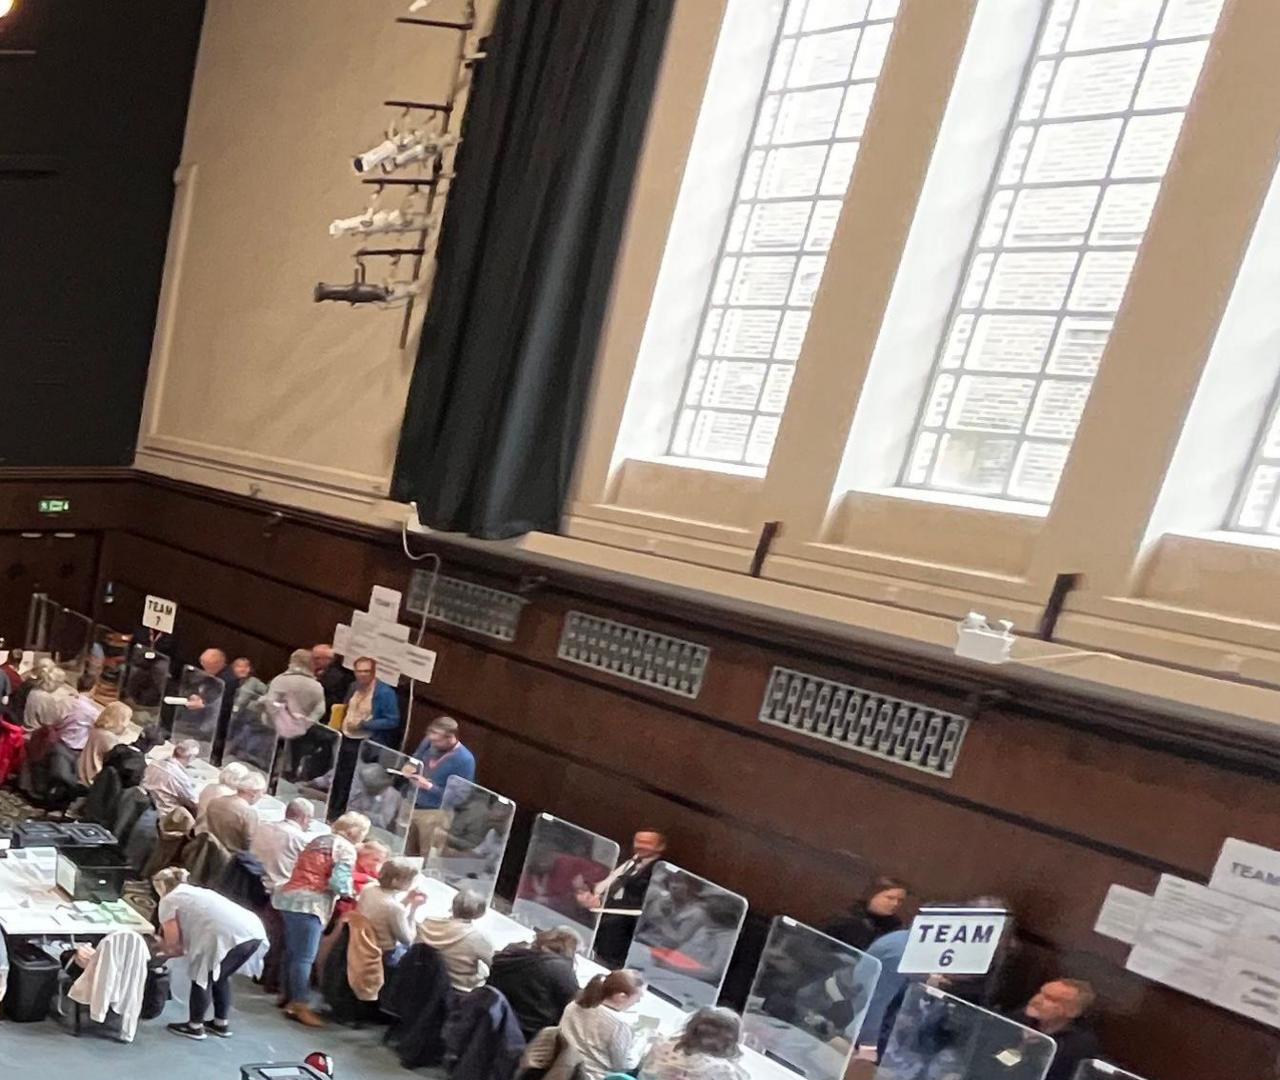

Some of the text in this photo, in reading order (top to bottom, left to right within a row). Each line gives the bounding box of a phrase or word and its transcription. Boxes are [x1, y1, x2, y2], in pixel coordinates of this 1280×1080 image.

[148, 599, 173, 615] TEAM
[917, 923, 995, 943] TEAM
[938, 948, 954, 967] 6
